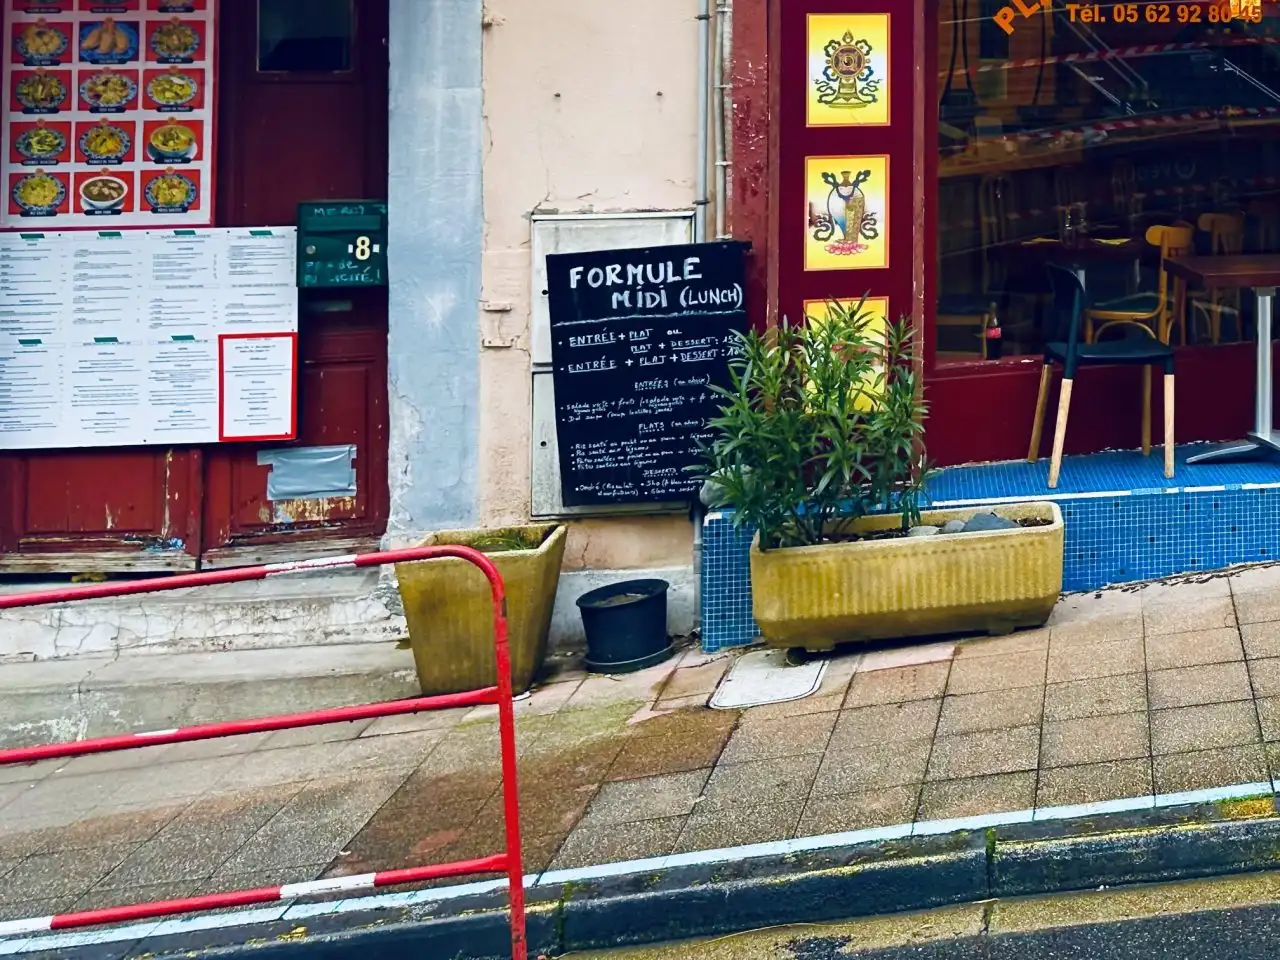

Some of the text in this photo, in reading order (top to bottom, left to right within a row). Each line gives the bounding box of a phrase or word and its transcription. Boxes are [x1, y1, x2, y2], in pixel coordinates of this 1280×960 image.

[1066, 3, 1262, 23] Tél. 05 62 92 80 45
[355, 236, 371, 260] 8
[569, 257, 702, 289] FORMULE
[679, 283, 743, 308] (LUNCH)
[569, 327, 616, 347] ENTRÉE
[629, 329, 653, 339] PLAT
[631, 343, 652, 352] PLAT
[568, 355, 617, 372] ENTRÉE
[639, 355, 667, 366] PLAT
